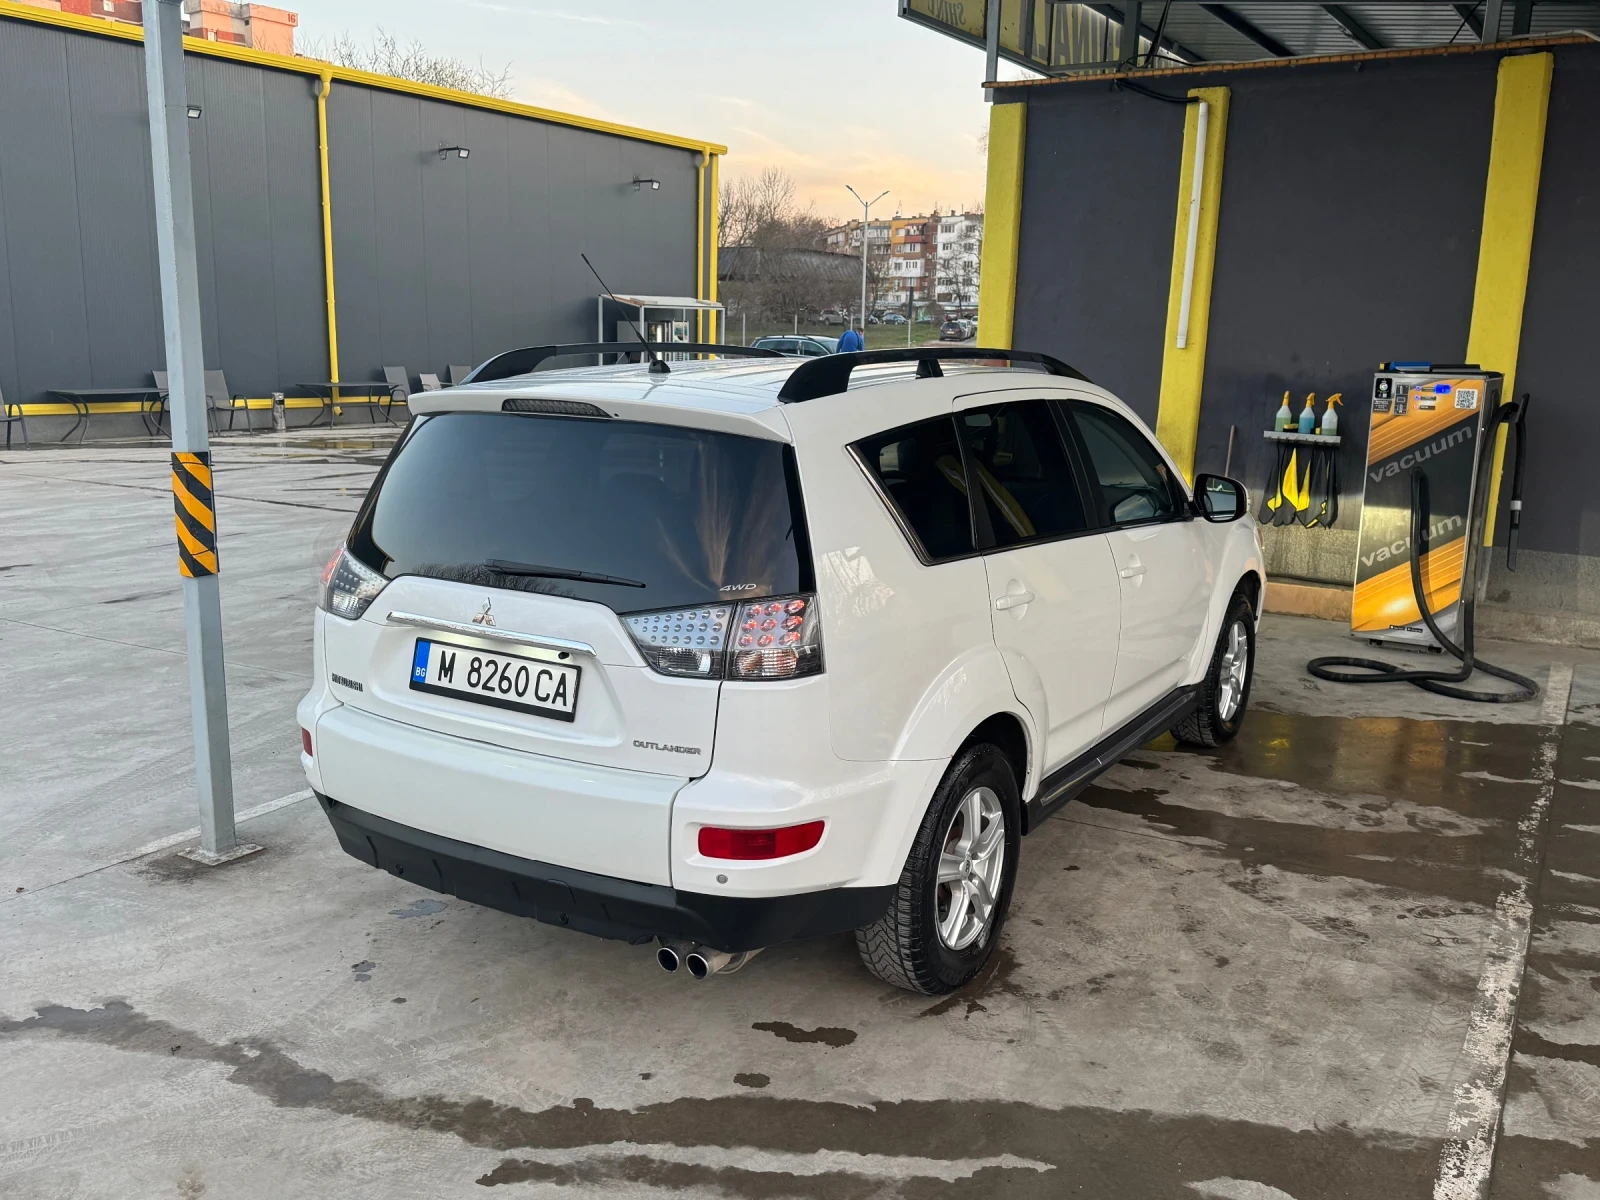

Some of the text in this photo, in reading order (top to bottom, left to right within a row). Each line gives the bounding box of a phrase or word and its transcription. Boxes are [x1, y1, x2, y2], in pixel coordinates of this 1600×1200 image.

[287, 13, 296, 23] 16
[1369, 426, 1473, 483] vacuum
[719, 583, 757, 592] 4WD
[415, 666, 426, 677] BG
[438, 650, 568, 707] M 8260 CA
[633, 739, 701, 755] OUTLANDER
